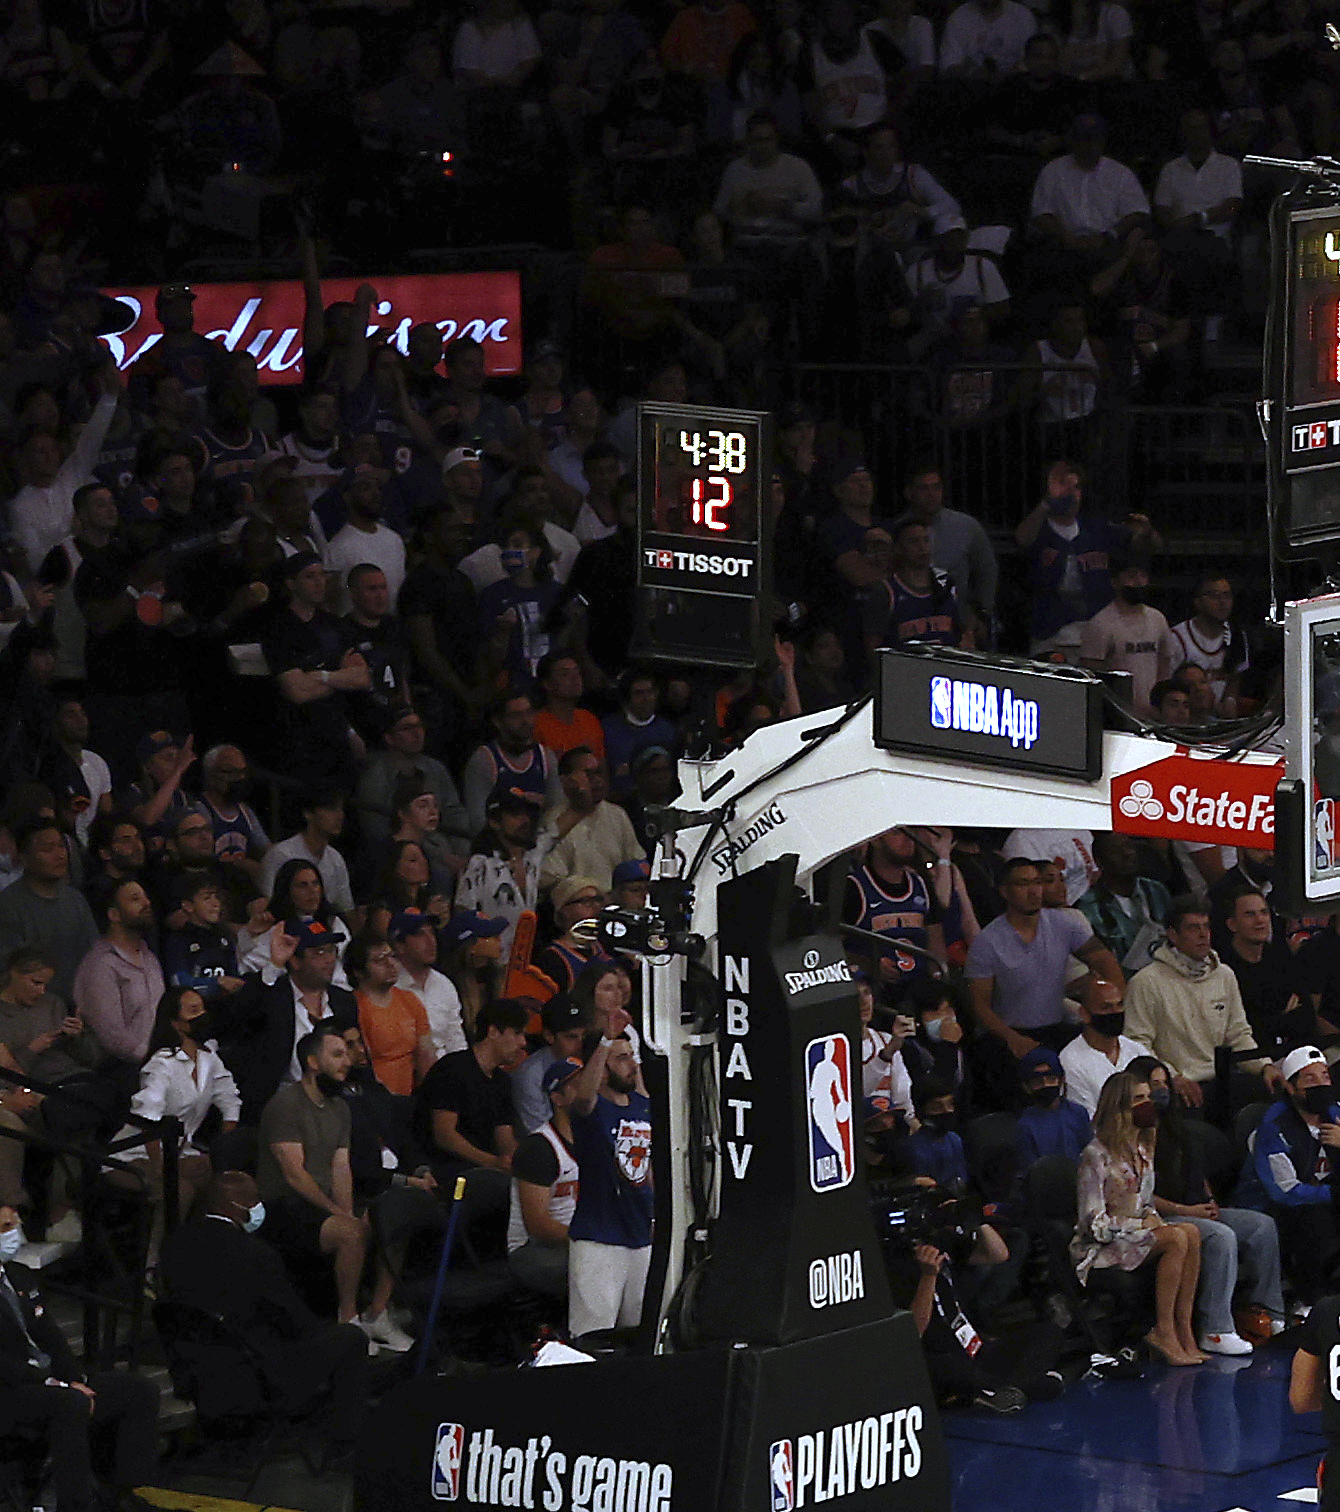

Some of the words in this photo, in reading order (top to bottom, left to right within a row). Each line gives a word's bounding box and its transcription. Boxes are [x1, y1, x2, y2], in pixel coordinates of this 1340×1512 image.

[680, 430, 748, 474] 4:38
[692, 476, 732, 531] 12
[673, 551, 754, 577] TISSOT
[952, 680, 1000, 737] NBA
[1000, 687, 1040, 751] App
[711, 801, 787, 876] SPALDING
[1166, 784, 1246, 825] State
[1248, 794, 1276, 834] Fa
[784, 958, 852, 996] SPALDING
[726, 954, 754, 1081] NBA
[727, 1098, 754, 1181] TV
[808, 1249, 866, 1310] @NBA
[467, 1429, 567, 1512] that's
[796, 1405, 923, 1510] PLAYOFFS
